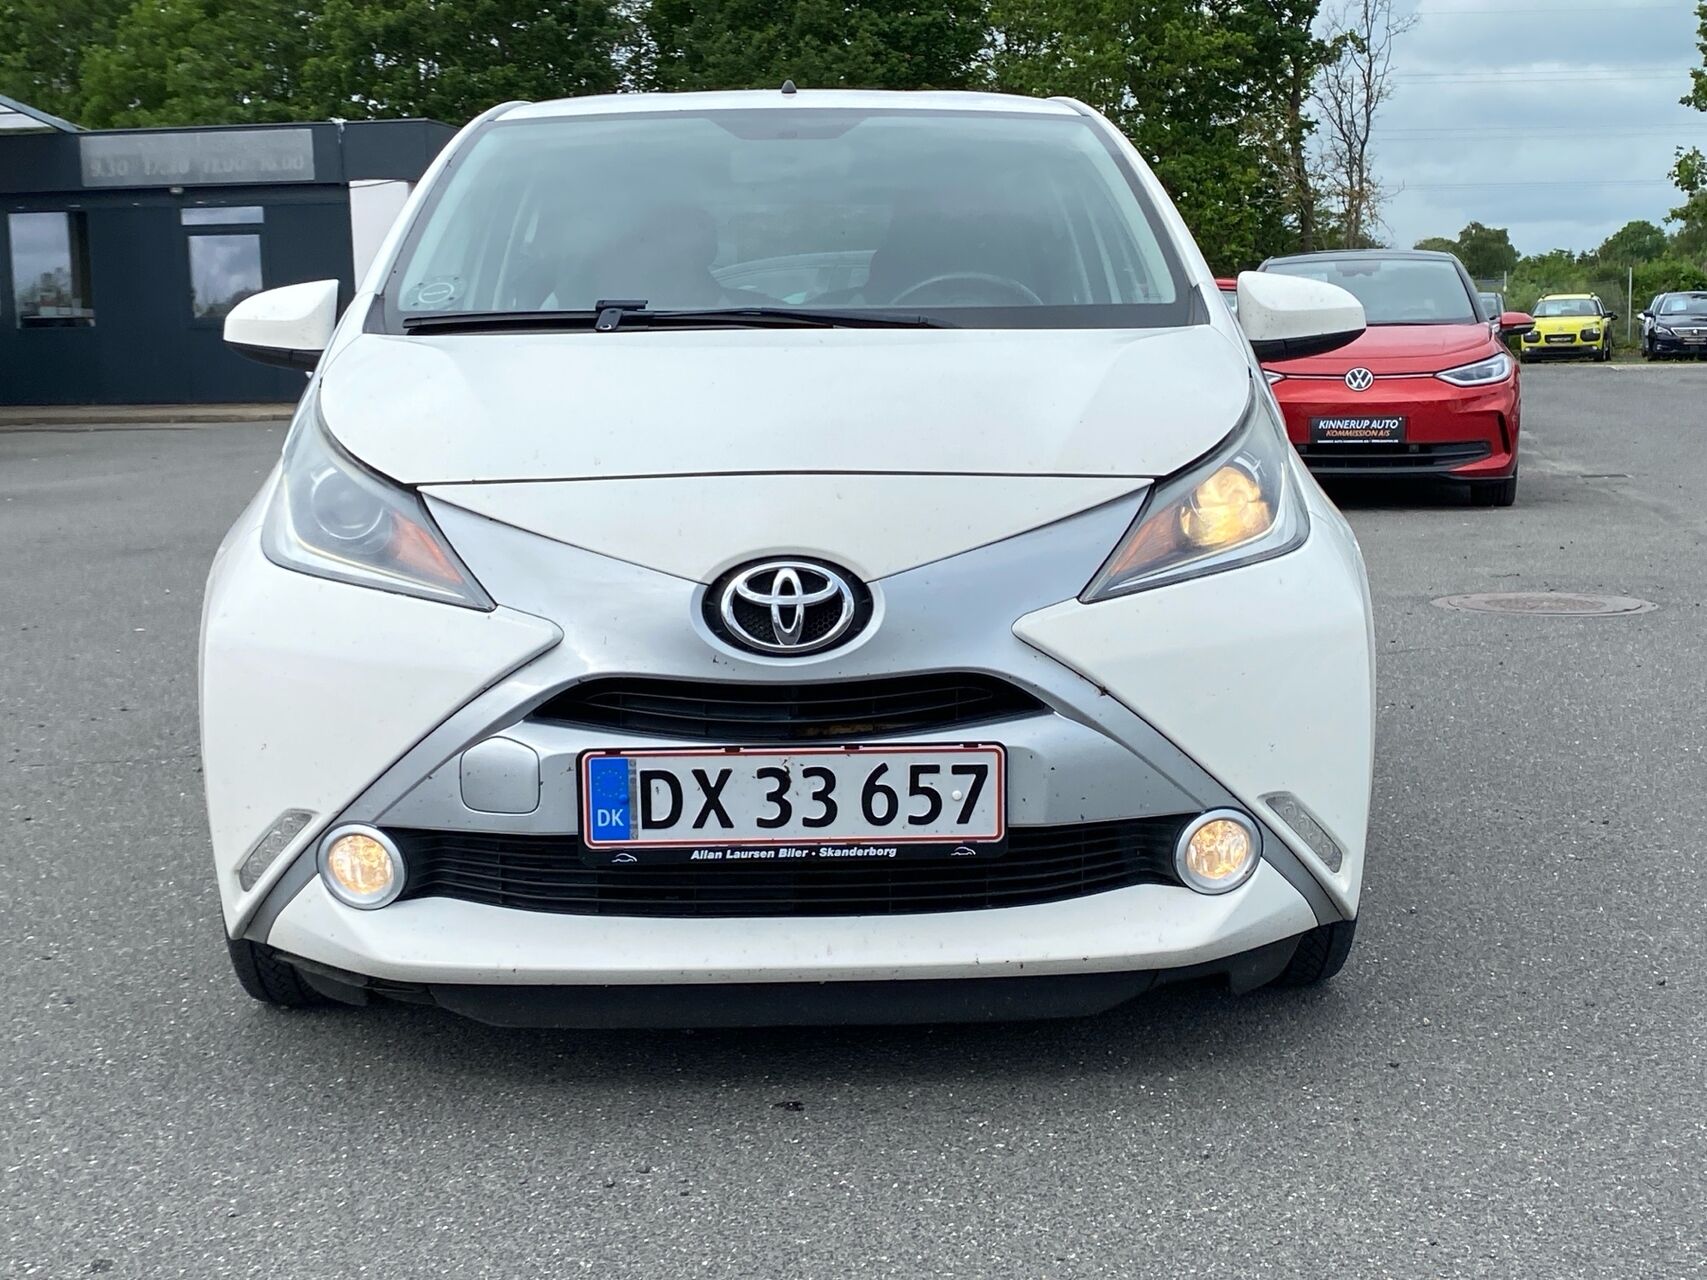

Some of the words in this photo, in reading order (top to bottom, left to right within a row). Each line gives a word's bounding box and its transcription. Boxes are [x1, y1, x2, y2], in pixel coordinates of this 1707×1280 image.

[1318, 419, 1370, 430] KINNERUP
[1370, 419, 1399, 430] AUTO
[1326, 429, 1378, 437] KOMMISSION
[1378, 429, 1391, 437] A/S
[639, 767, 735, 830] DX
[755, 765, 839, 829] 33
[860, 762, 990, 827] 657
[597, 808, 625, 828] DK
[690, 849, 722, 860] Allan
[726, 848, 775, 860] Laursen
[778, 848, 809, 859] Biler
[819, 846, 897, 859] Skanderborg
